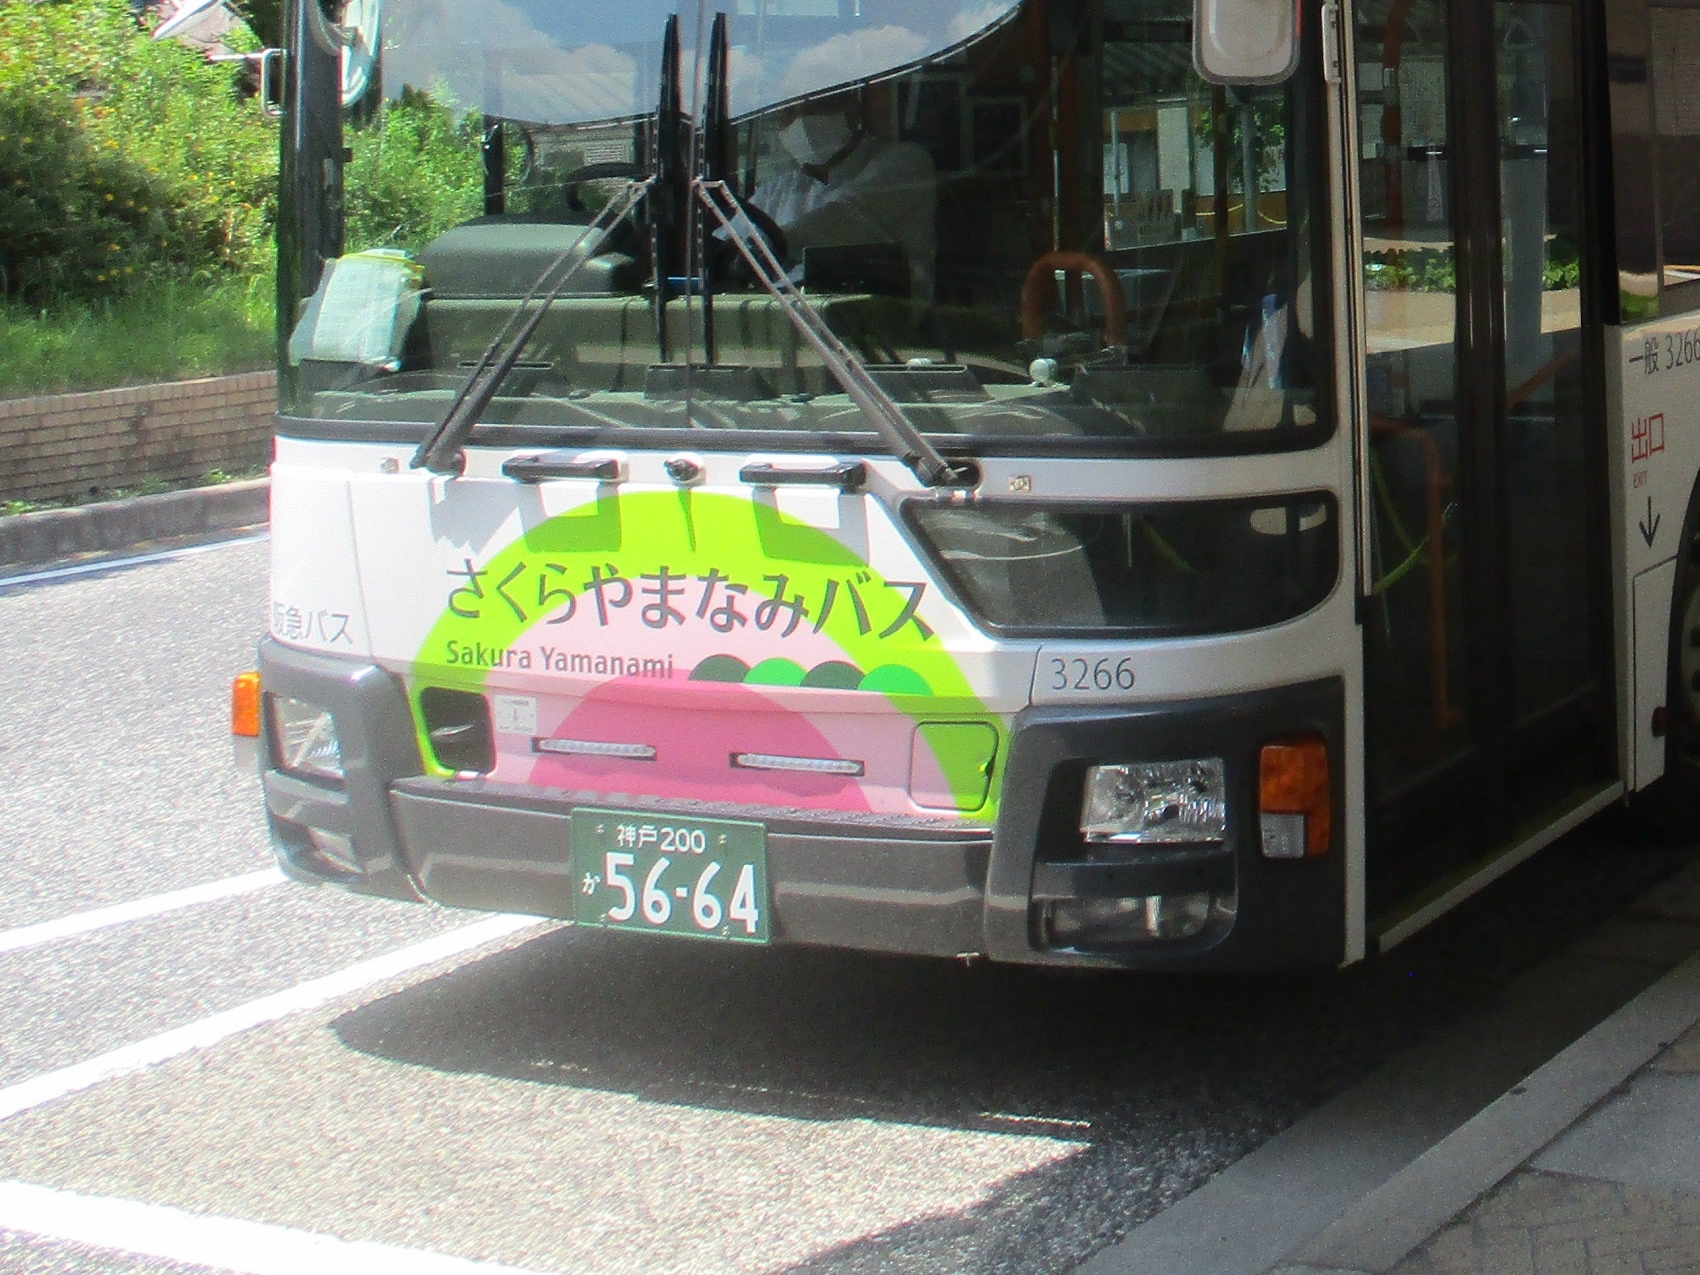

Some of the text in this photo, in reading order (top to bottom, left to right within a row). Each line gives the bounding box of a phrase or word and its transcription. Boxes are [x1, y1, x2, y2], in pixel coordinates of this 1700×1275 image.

[1629, 336, 1659, 374] 一般
[1632, 413, 1665, 464] 出口
[446, 558, 936, 641] さくらやまなみバス
[446, 640, 674, 680] Sakura Yamanami
[1050, 656, 1135, 691] 3266
[581, 852, 759, 934] か 56-64
